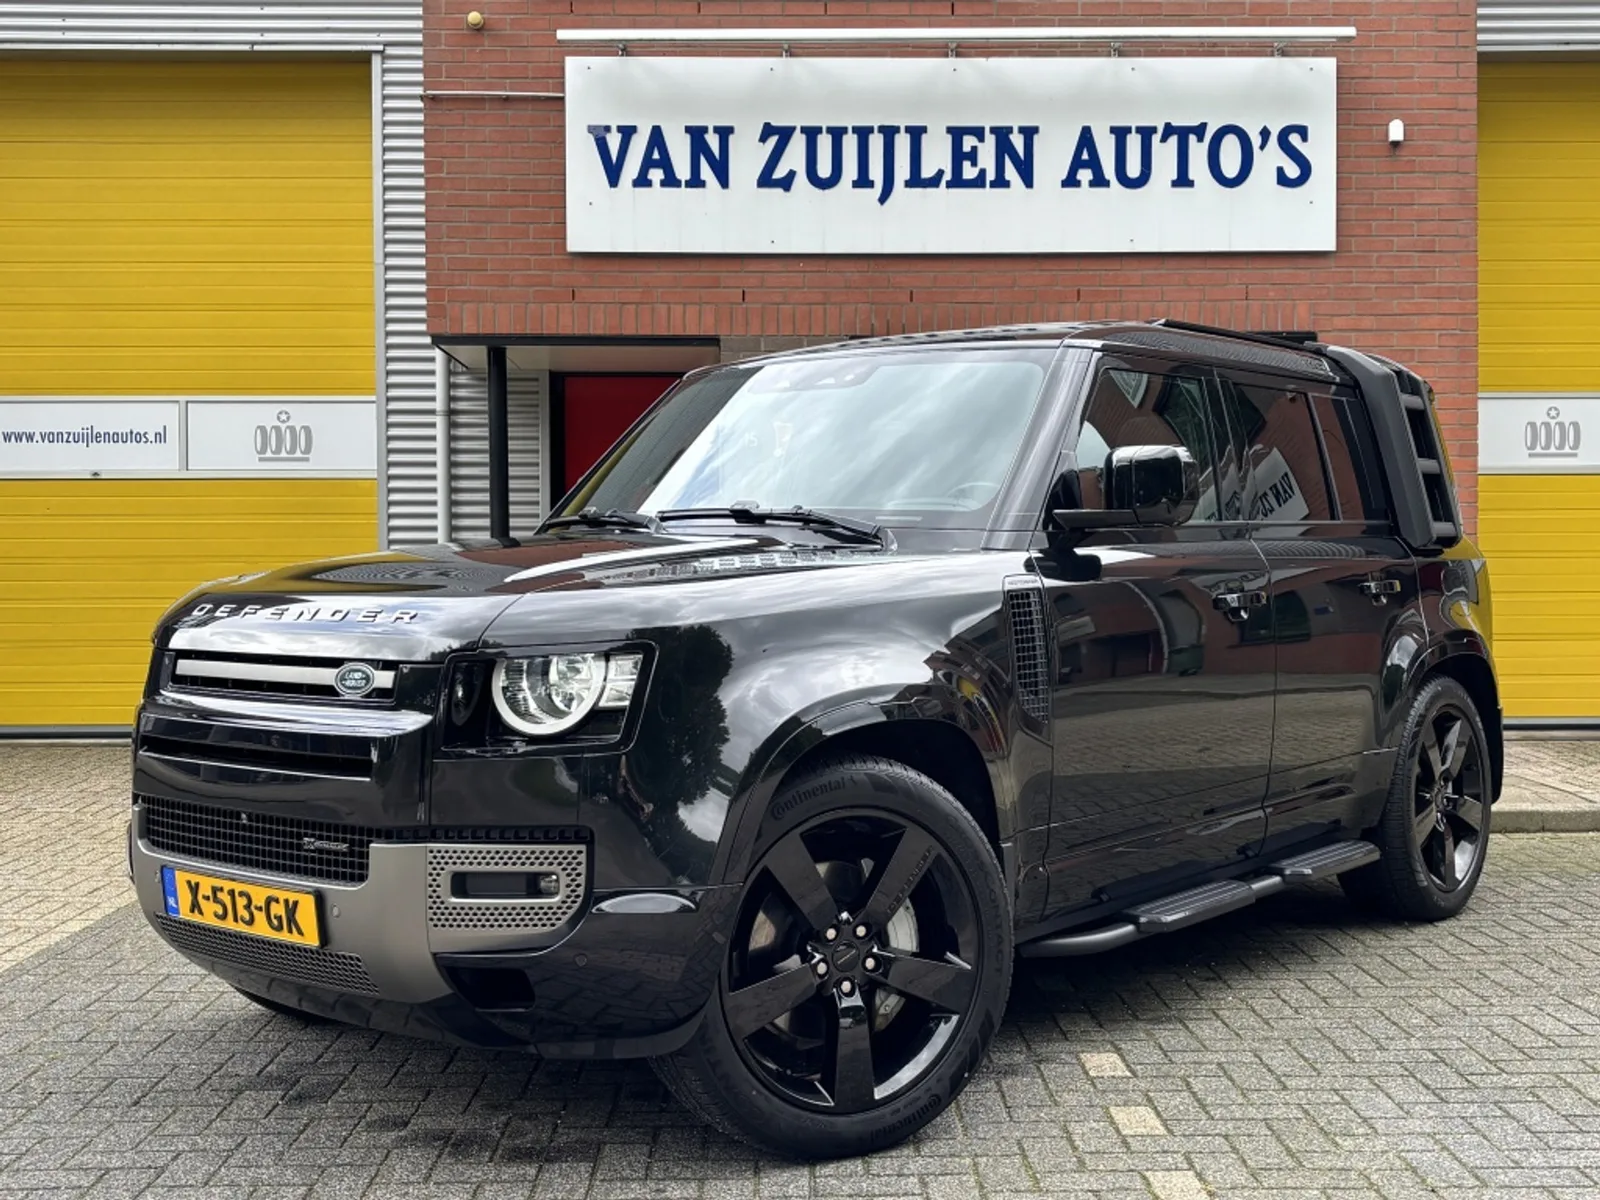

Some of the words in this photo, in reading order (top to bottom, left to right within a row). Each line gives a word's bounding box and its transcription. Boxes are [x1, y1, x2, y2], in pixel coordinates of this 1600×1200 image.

[587, 124, 735, 189] VAN
[757, 122, 1040, 206] ZUIJLEN
[1061, 121, 1312, 190] AUTO'S
[1, 425, 167, 448] www.vanzuijlenautos.nl
[191, 604, 419, 624] DEFENDER
[770, 776, 846, 821] Continental
[185, 879, 304, 937] X-513-GK
